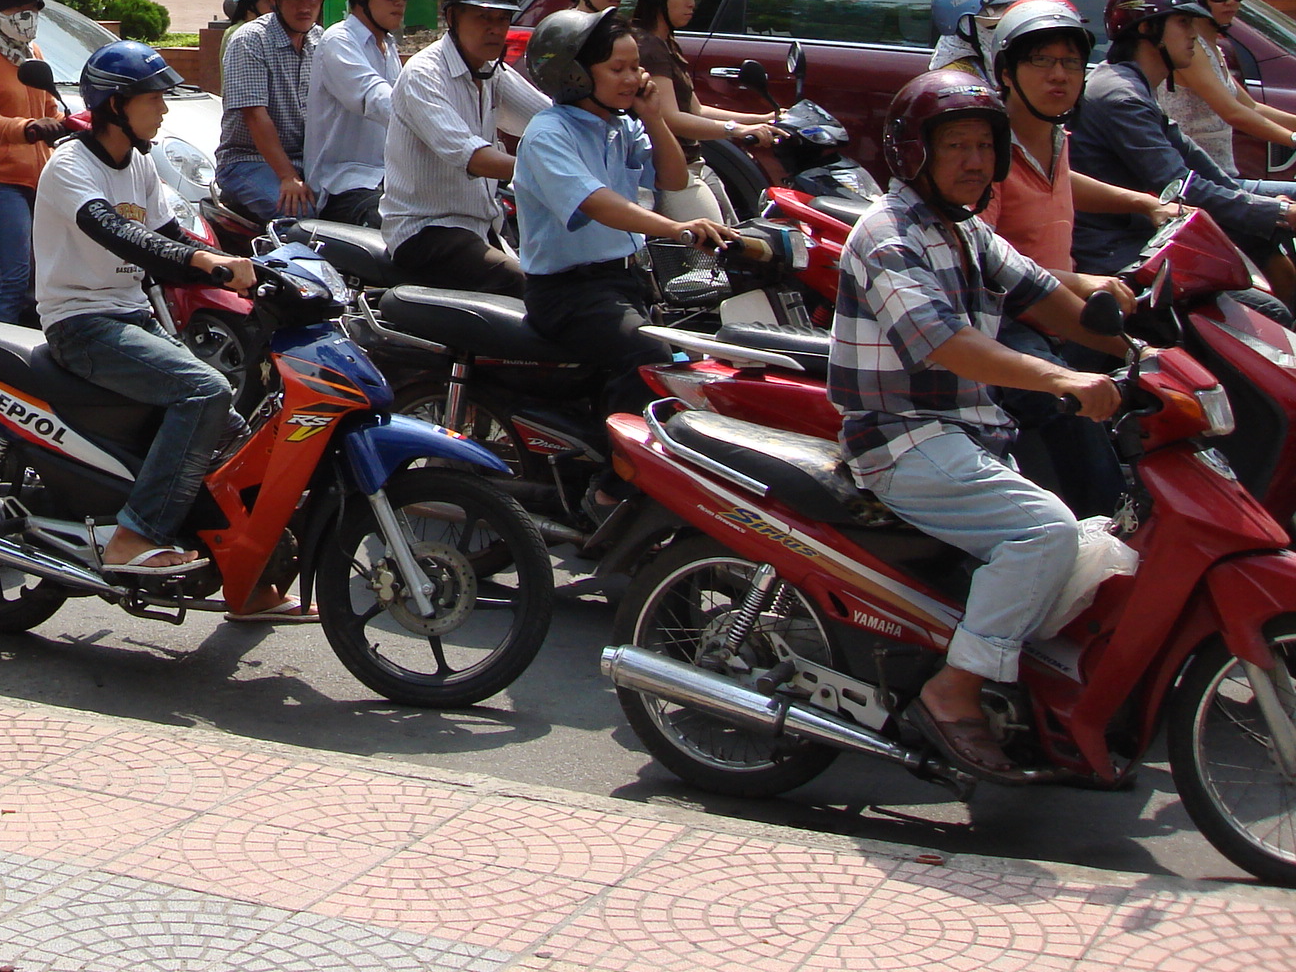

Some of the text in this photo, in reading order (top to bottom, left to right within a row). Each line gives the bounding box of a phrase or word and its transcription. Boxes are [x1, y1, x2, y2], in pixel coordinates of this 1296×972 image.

[116, 223, 153, 249] BASIC
[718, 506, 820, 558] Sirius
[853, 610, 903, 638] YAMAHA
